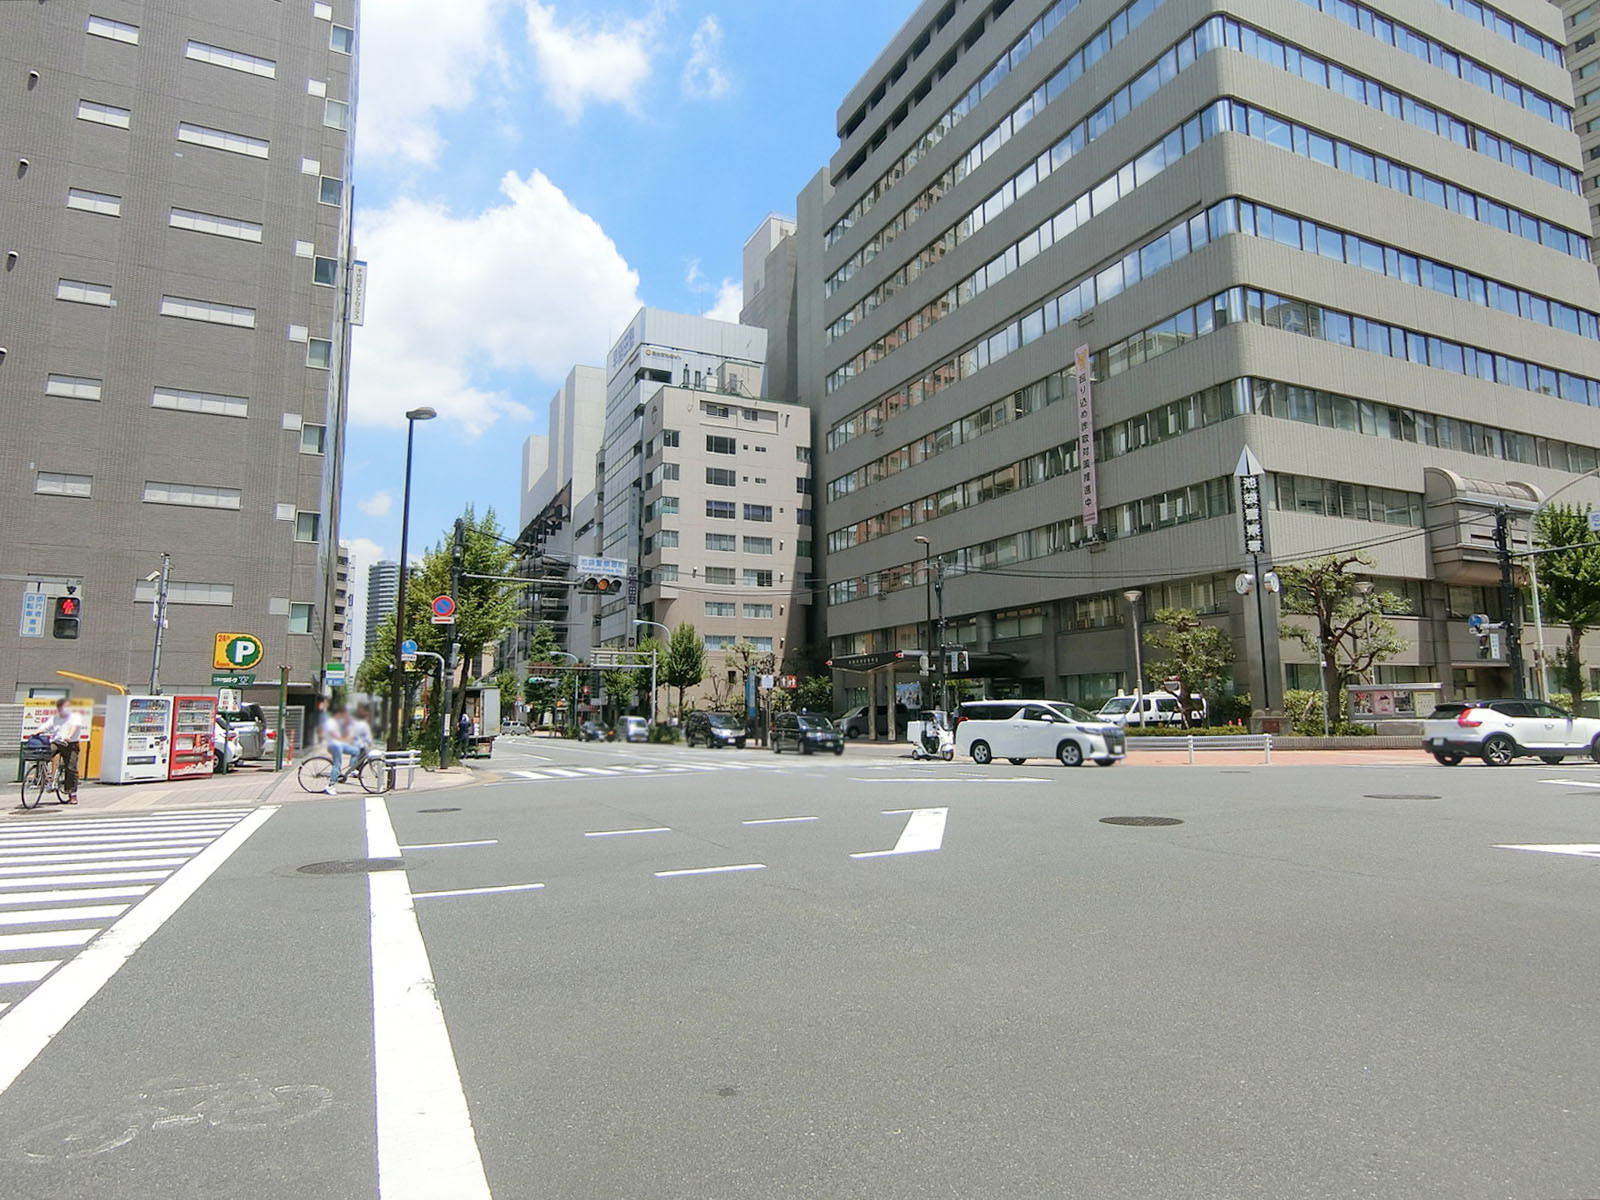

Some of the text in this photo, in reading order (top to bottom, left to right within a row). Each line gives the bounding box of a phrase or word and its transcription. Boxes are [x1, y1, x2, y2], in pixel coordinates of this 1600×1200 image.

[1243, 477, 1261, 552] 池袋警察署
[234, 640, 256, 663] P
